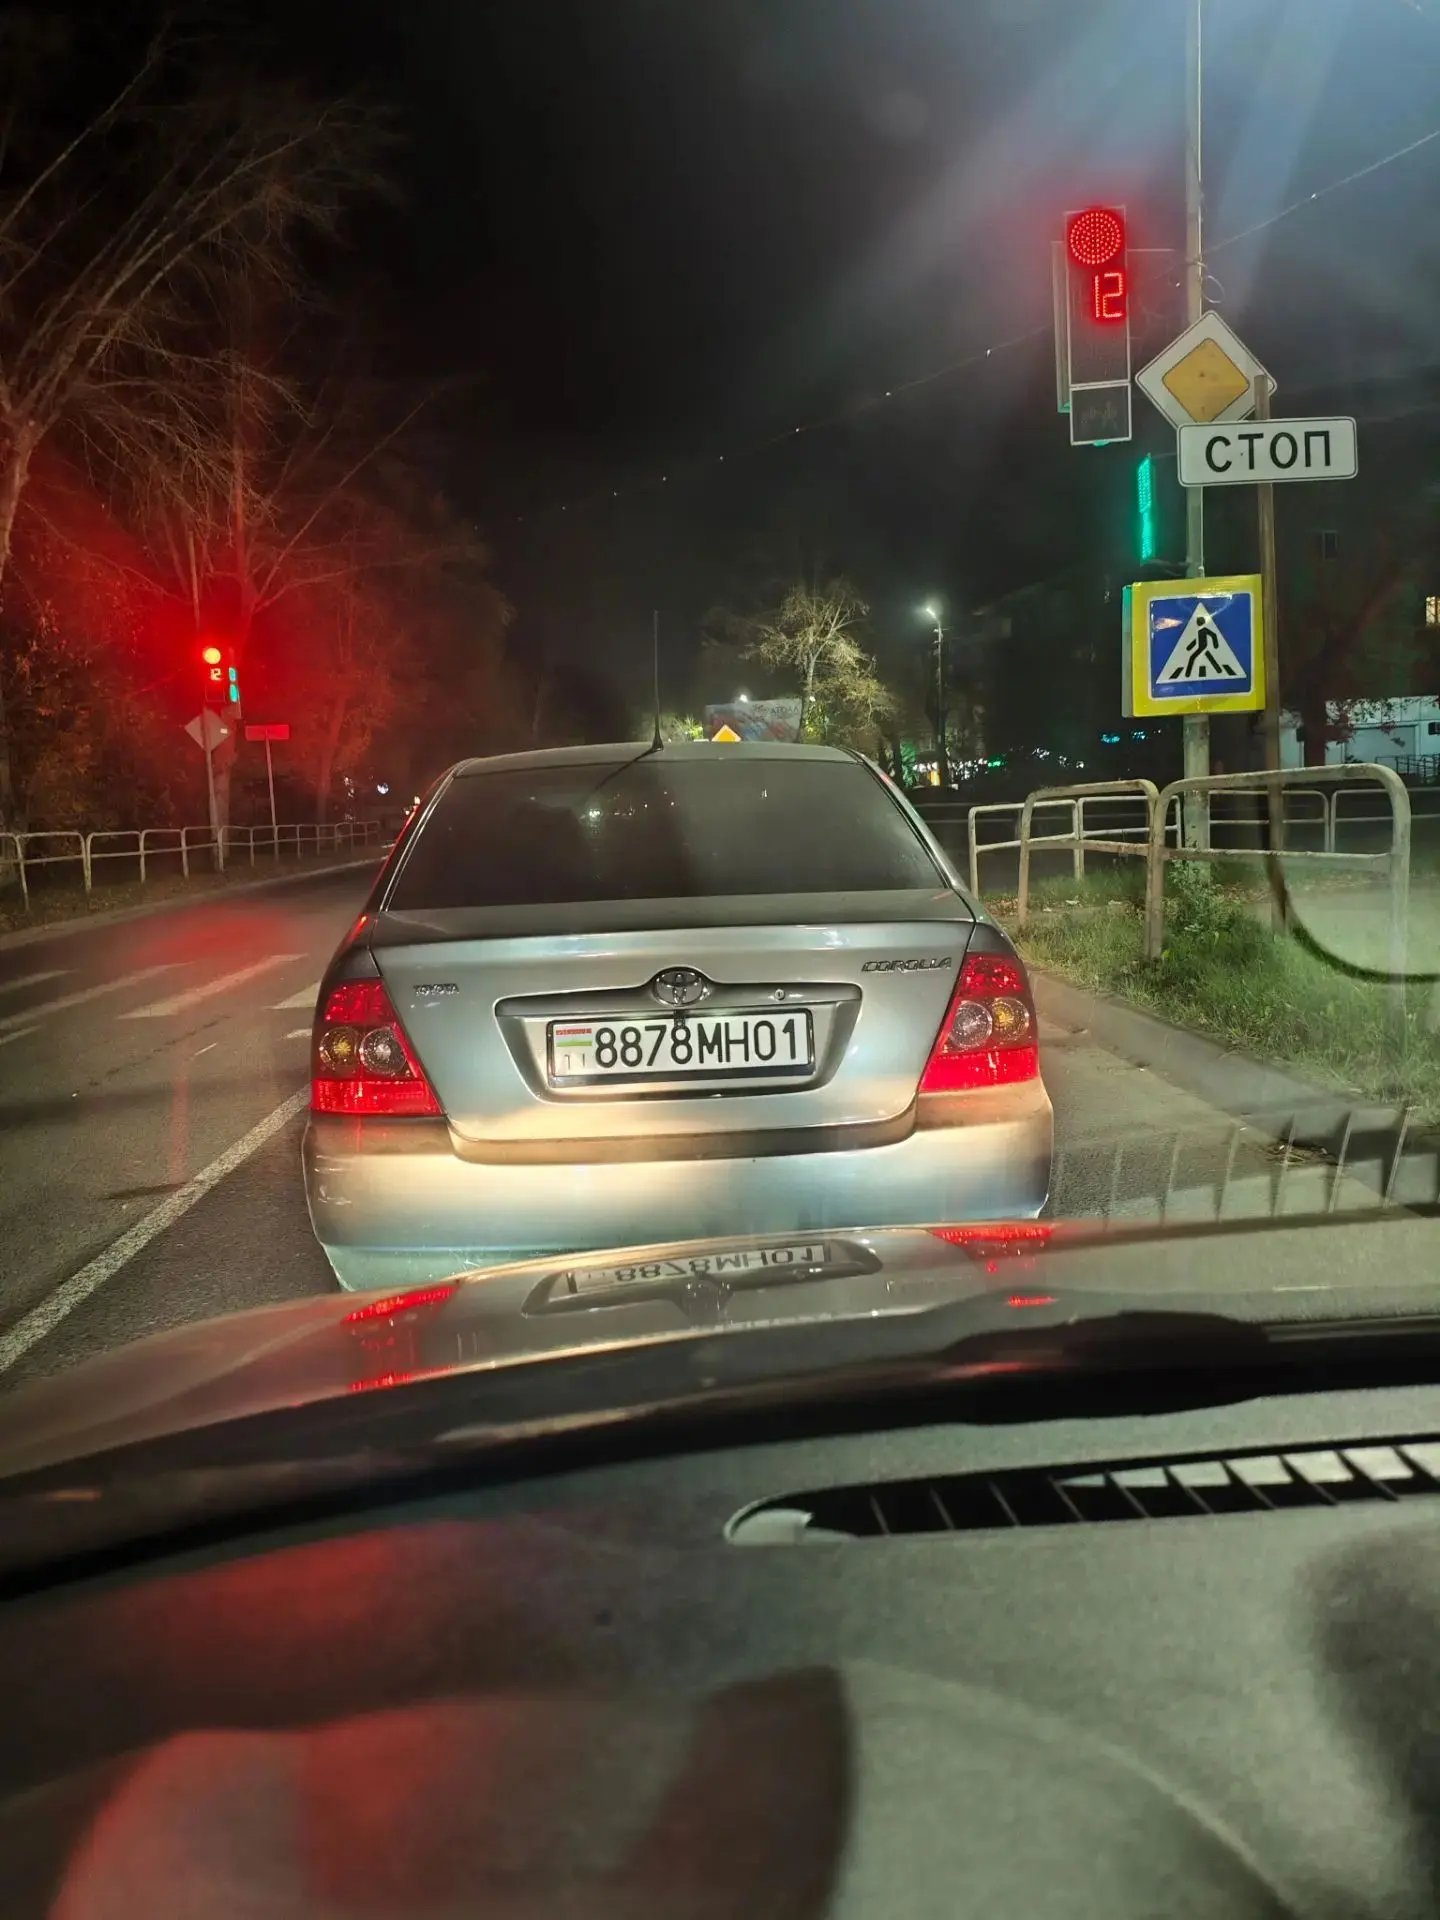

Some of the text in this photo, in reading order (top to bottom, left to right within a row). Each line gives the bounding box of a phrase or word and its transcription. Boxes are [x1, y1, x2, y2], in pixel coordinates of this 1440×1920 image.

[1094, 272, 1123, 318] 12
[1205, 430, 1331, 473] СТОП
[861, 957, 952, 972] COROLLA
[595, 1018, 797, 1068] 8878MH01
